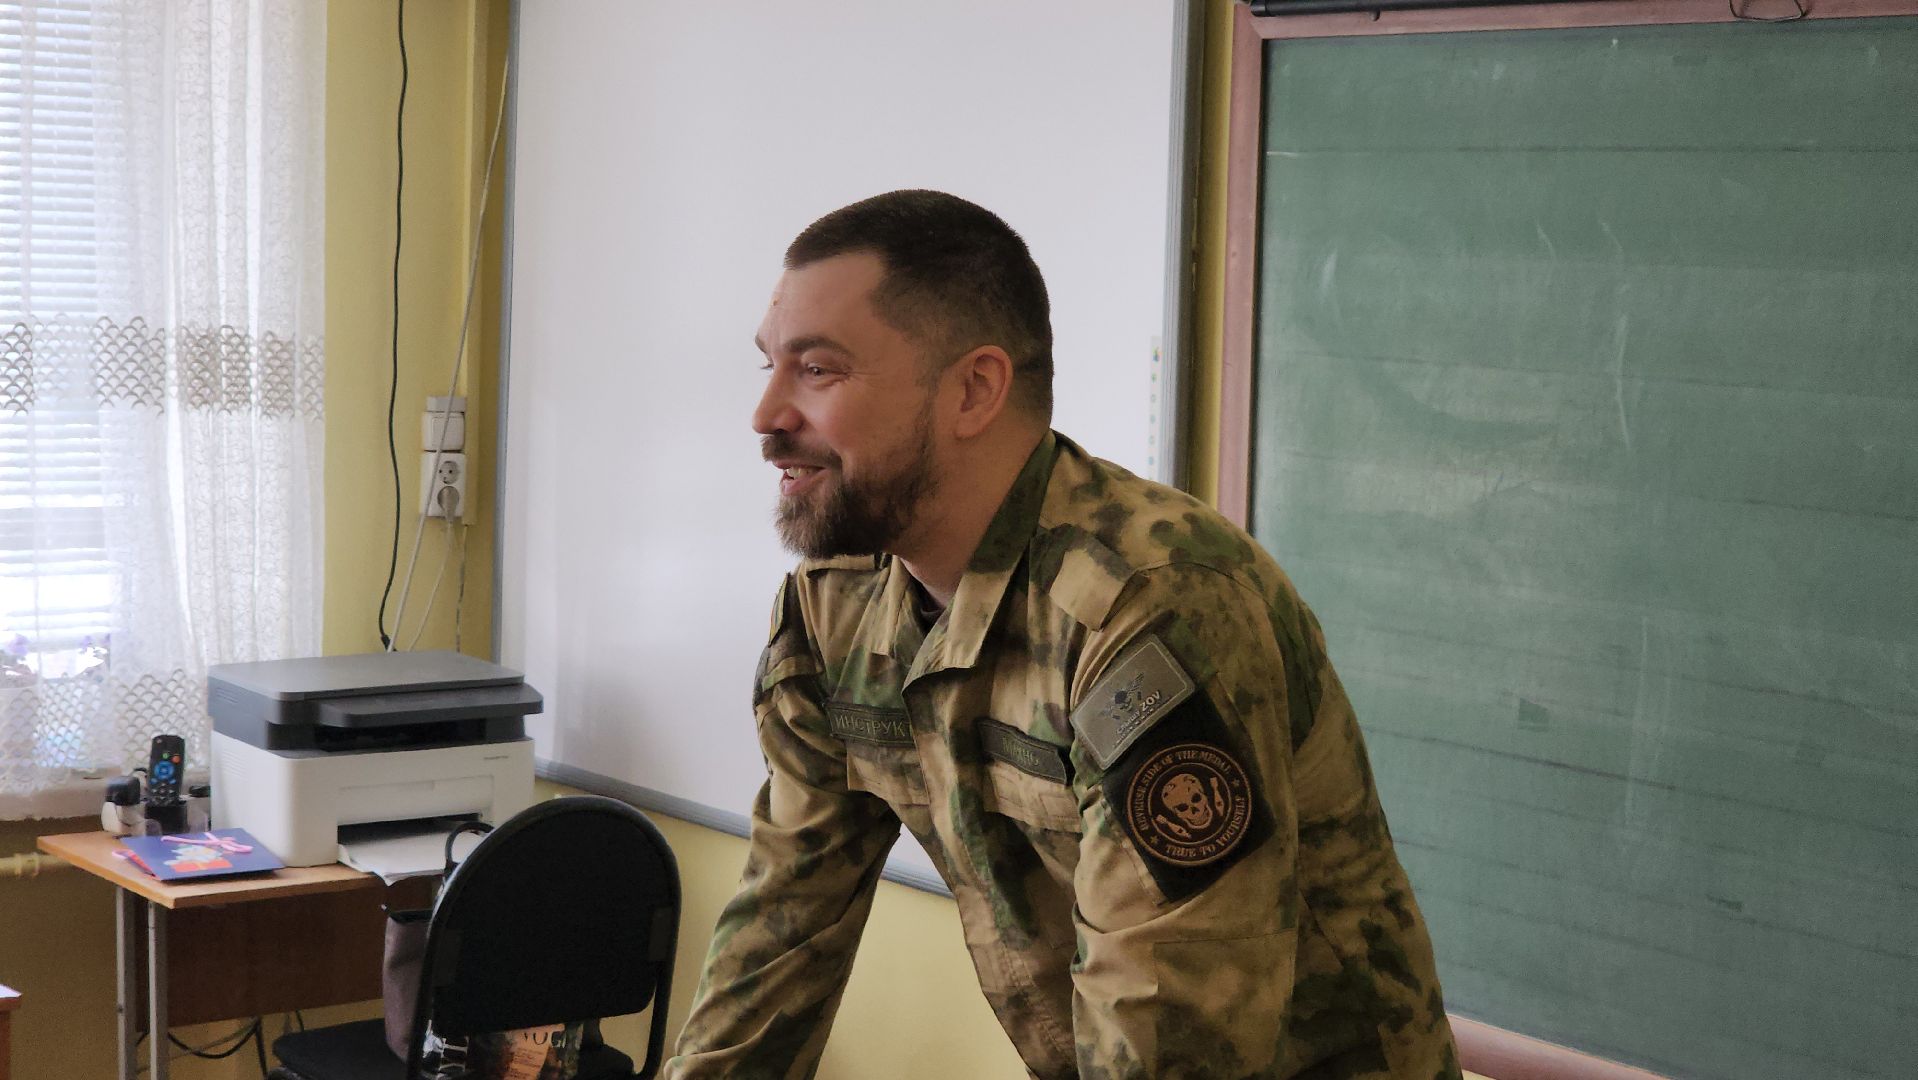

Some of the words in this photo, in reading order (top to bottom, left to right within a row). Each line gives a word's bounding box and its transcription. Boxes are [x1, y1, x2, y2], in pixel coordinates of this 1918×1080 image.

[1140, 690, 1161, 712] ZOV
[1133, 784, 1150, 832] REVERSE
[1143, 761, 1162, 784] SIDE
[1161, 754, 1174, 765] OF
[1176, 750, 1198, 761] THE
[1200, 750, 1232, 775] MEDAL
[1166, 844, 1198, 858] TRUE
[1201, 844, 1217, 857] TO
[1216, 795, 1246, 848] YOURSELF
